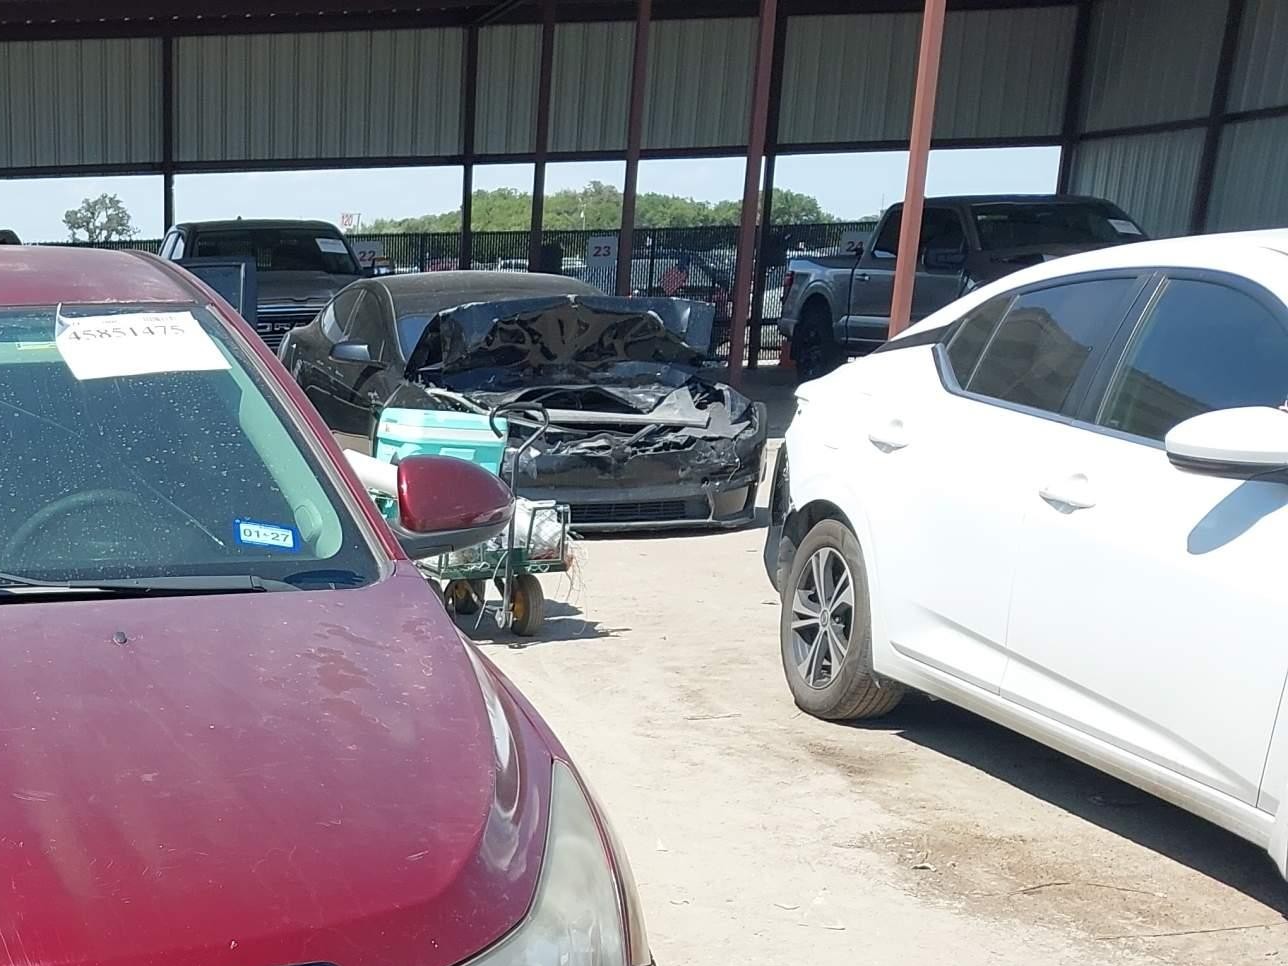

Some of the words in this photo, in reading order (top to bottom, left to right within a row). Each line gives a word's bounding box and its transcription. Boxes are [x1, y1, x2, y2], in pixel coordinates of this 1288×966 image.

[592, 245, 612, 257] 23
[68, 325, 185, 341] 45851475
[243, 528, 290, 543] 01-27
